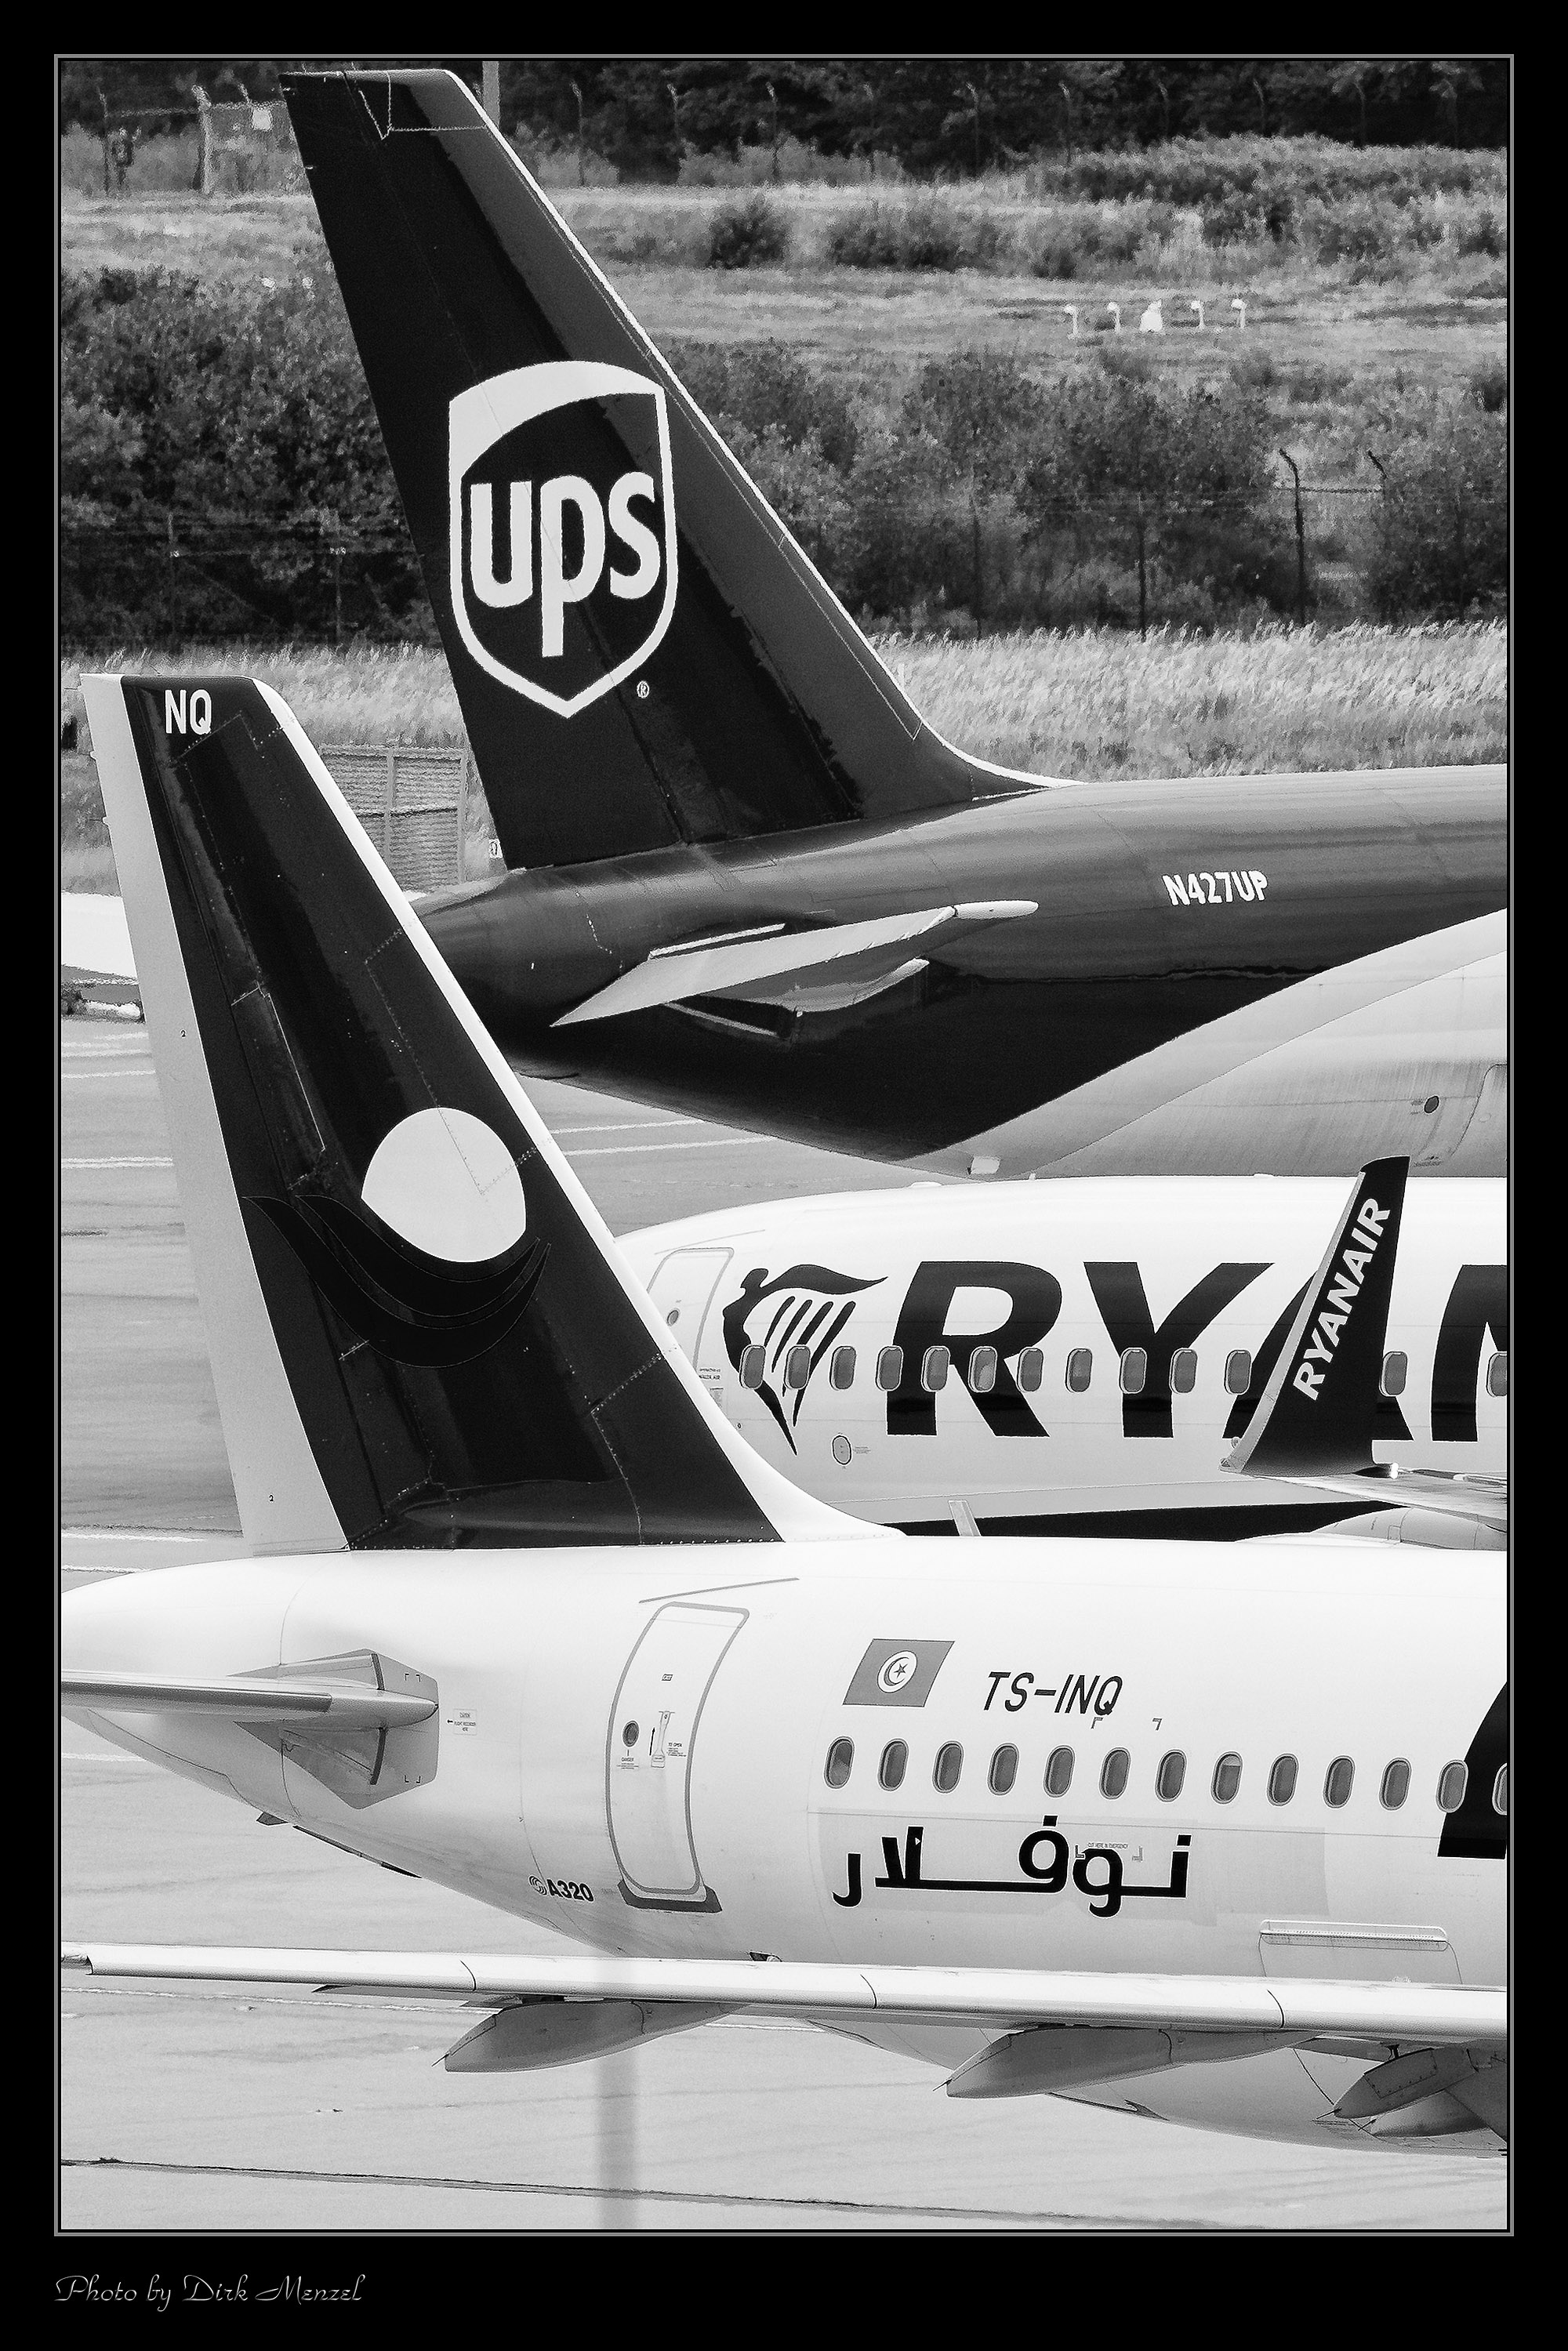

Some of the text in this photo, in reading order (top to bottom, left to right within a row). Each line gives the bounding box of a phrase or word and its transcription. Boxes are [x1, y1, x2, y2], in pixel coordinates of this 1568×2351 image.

[470, 472, 661, 658] ups
[165, 689, 212, 735] NQ
[1162, 870, 1268, 905] N427UP
[1293, 1198, 1391, 1401] RYANAIR
[983, 1671, 1123, 1716] TS-INQ
[546, 1879, 594, 1902] A320
